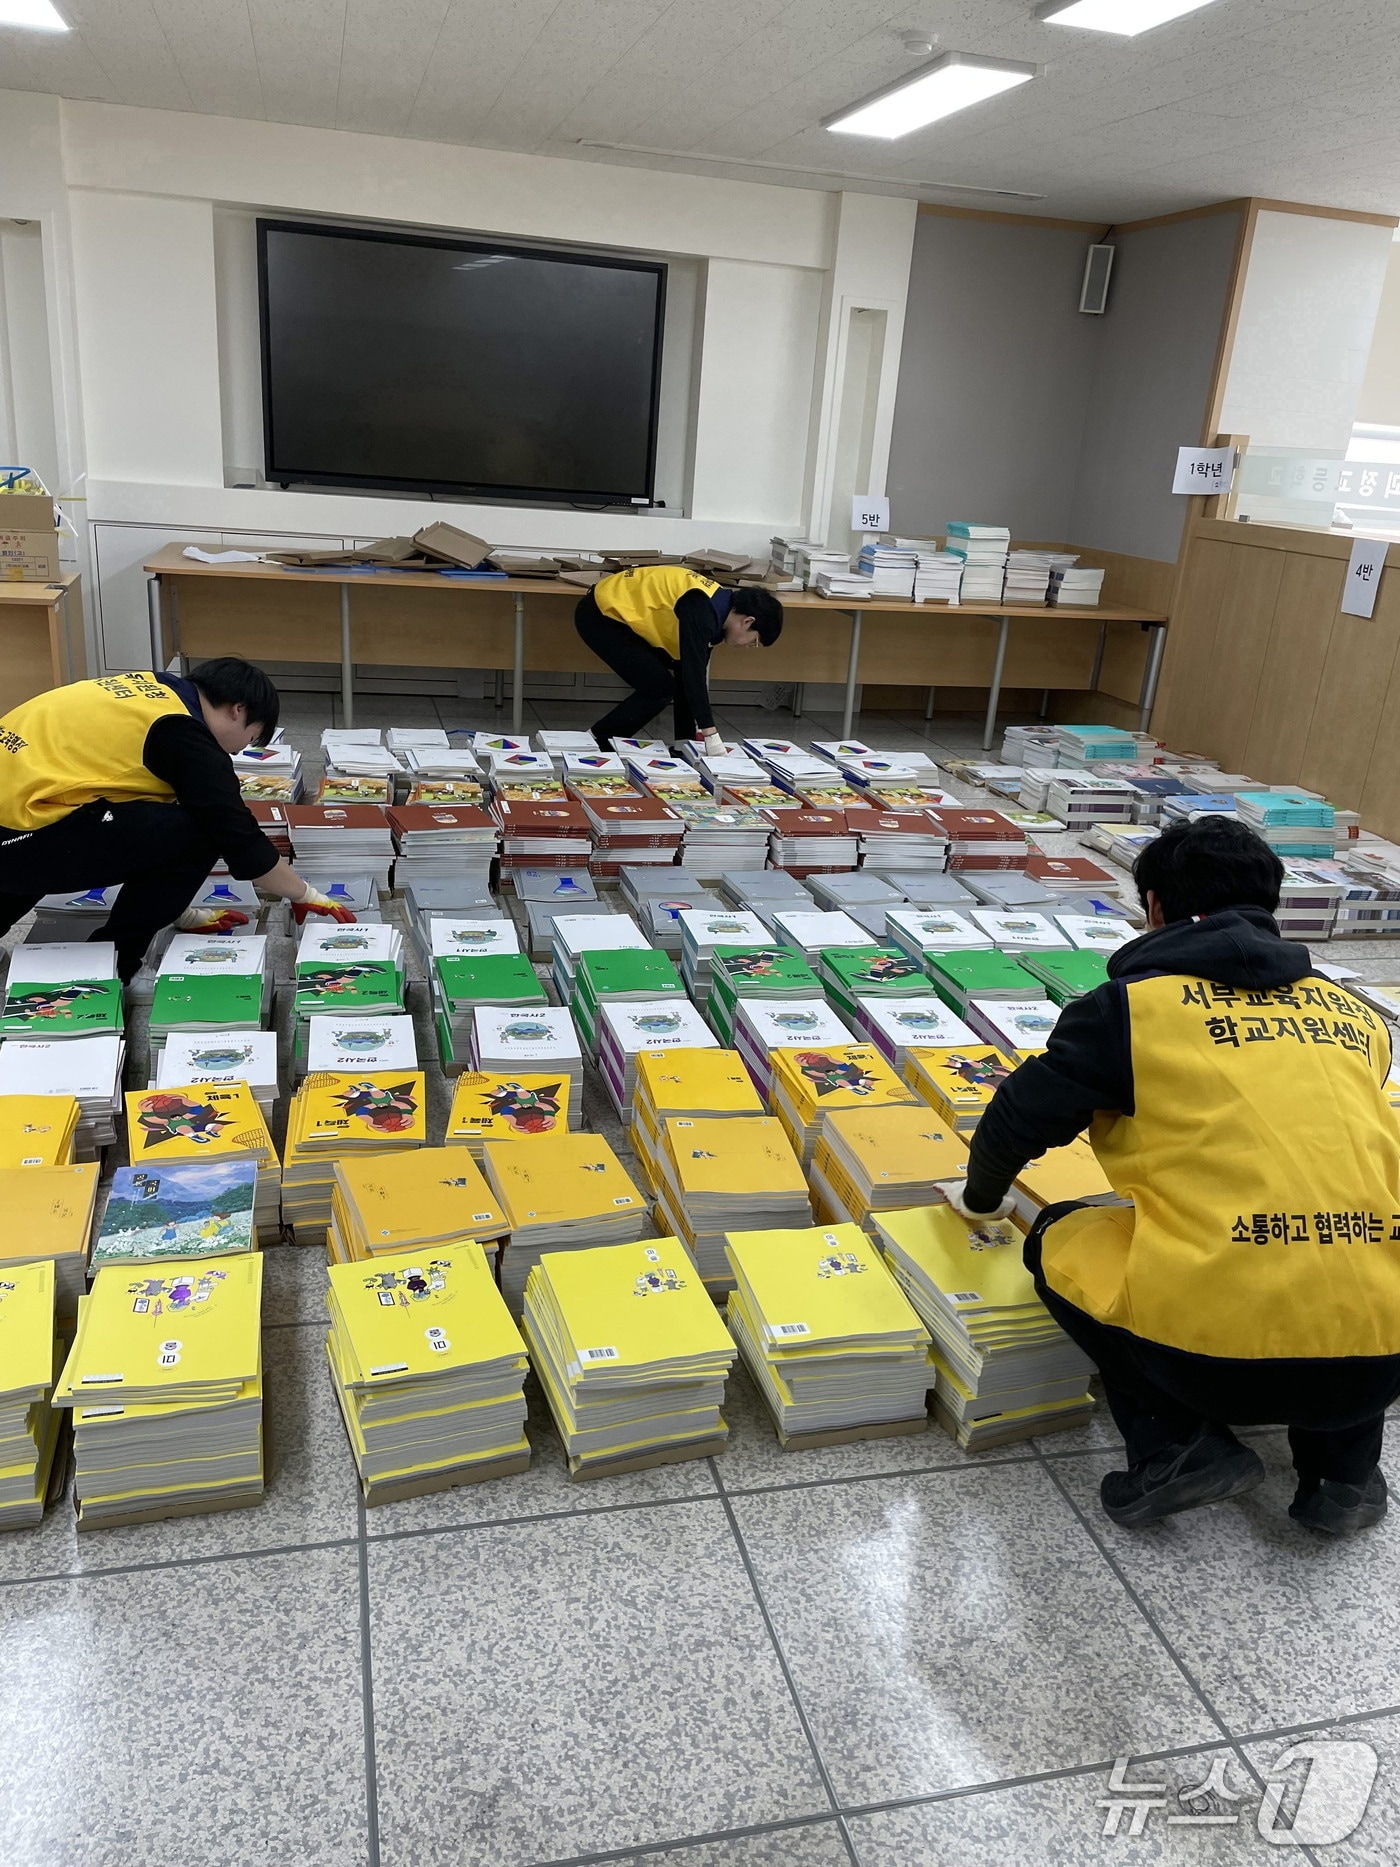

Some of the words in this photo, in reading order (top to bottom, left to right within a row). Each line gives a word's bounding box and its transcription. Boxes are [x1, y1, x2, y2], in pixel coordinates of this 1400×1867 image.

[1190, 462, 1223, 478] 1학년
[861, 513, 880, 527] 5반
[1355, 563, 1373, 581] 4반
[1181, 981, 1376, 1031] 서부교육지원청
[1205, 1015, 1373, 1068] 학교지원센터
[191, 1075, 235, 1084] 한국사2
[1231, 1212, 1310, 1246] 소통하고
[1313, 1210, 1384, 1245] 협력하는
